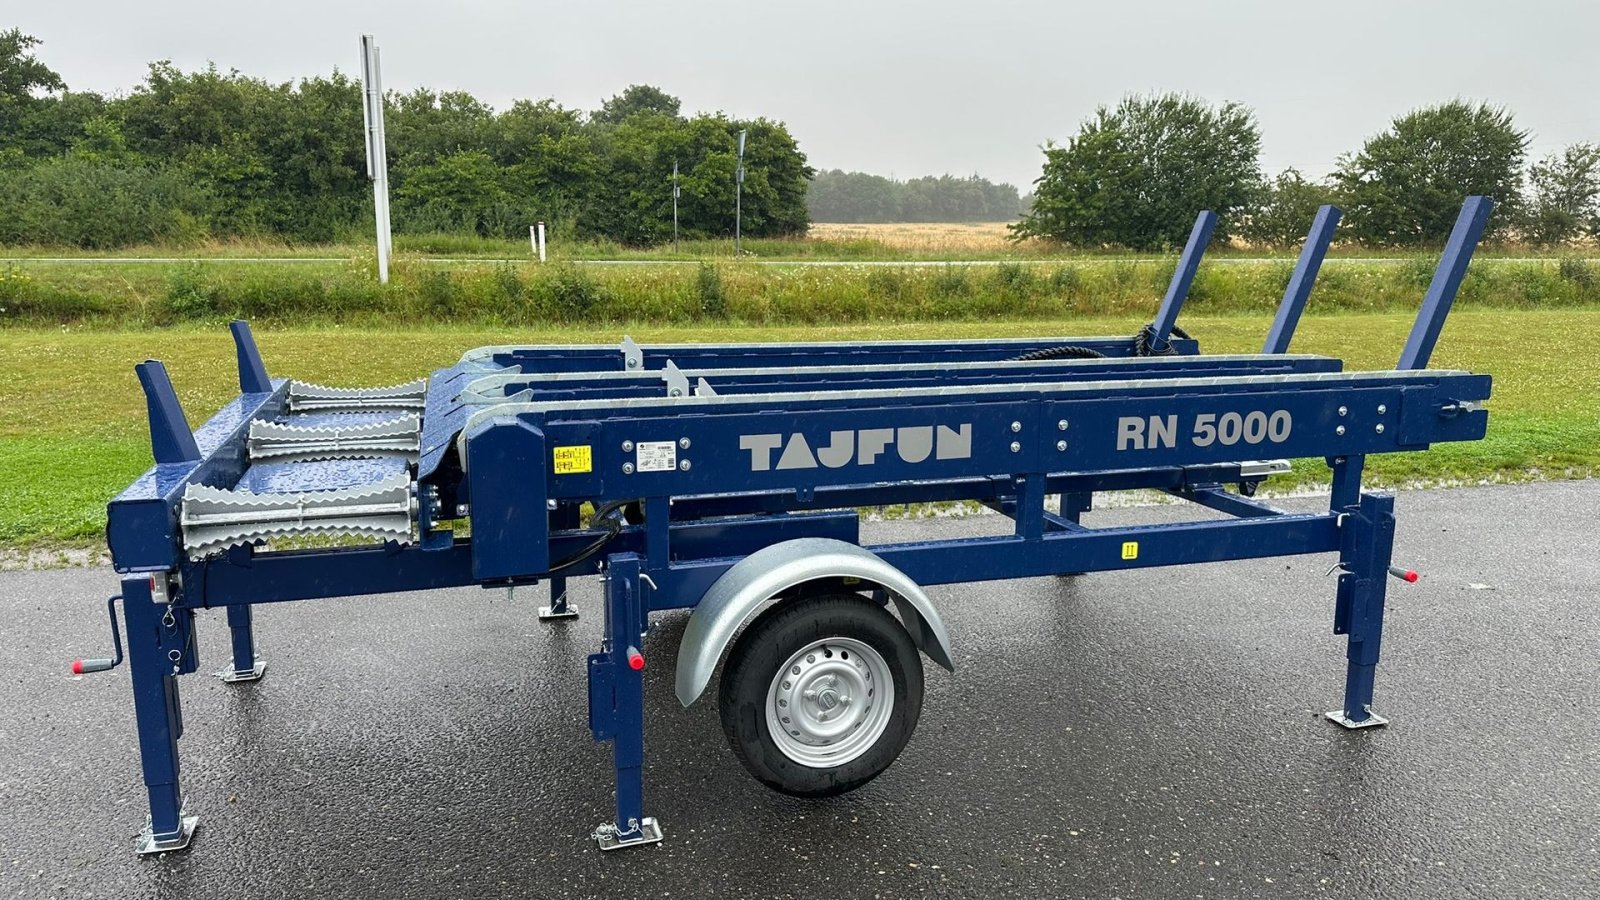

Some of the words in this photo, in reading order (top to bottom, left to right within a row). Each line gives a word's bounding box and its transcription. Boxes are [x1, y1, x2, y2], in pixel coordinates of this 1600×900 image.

[739, 423, 972, 472] TAJFUN
[1116, 414, 1178, 451] RN
[1191, 409, 1292, 448] 5000
